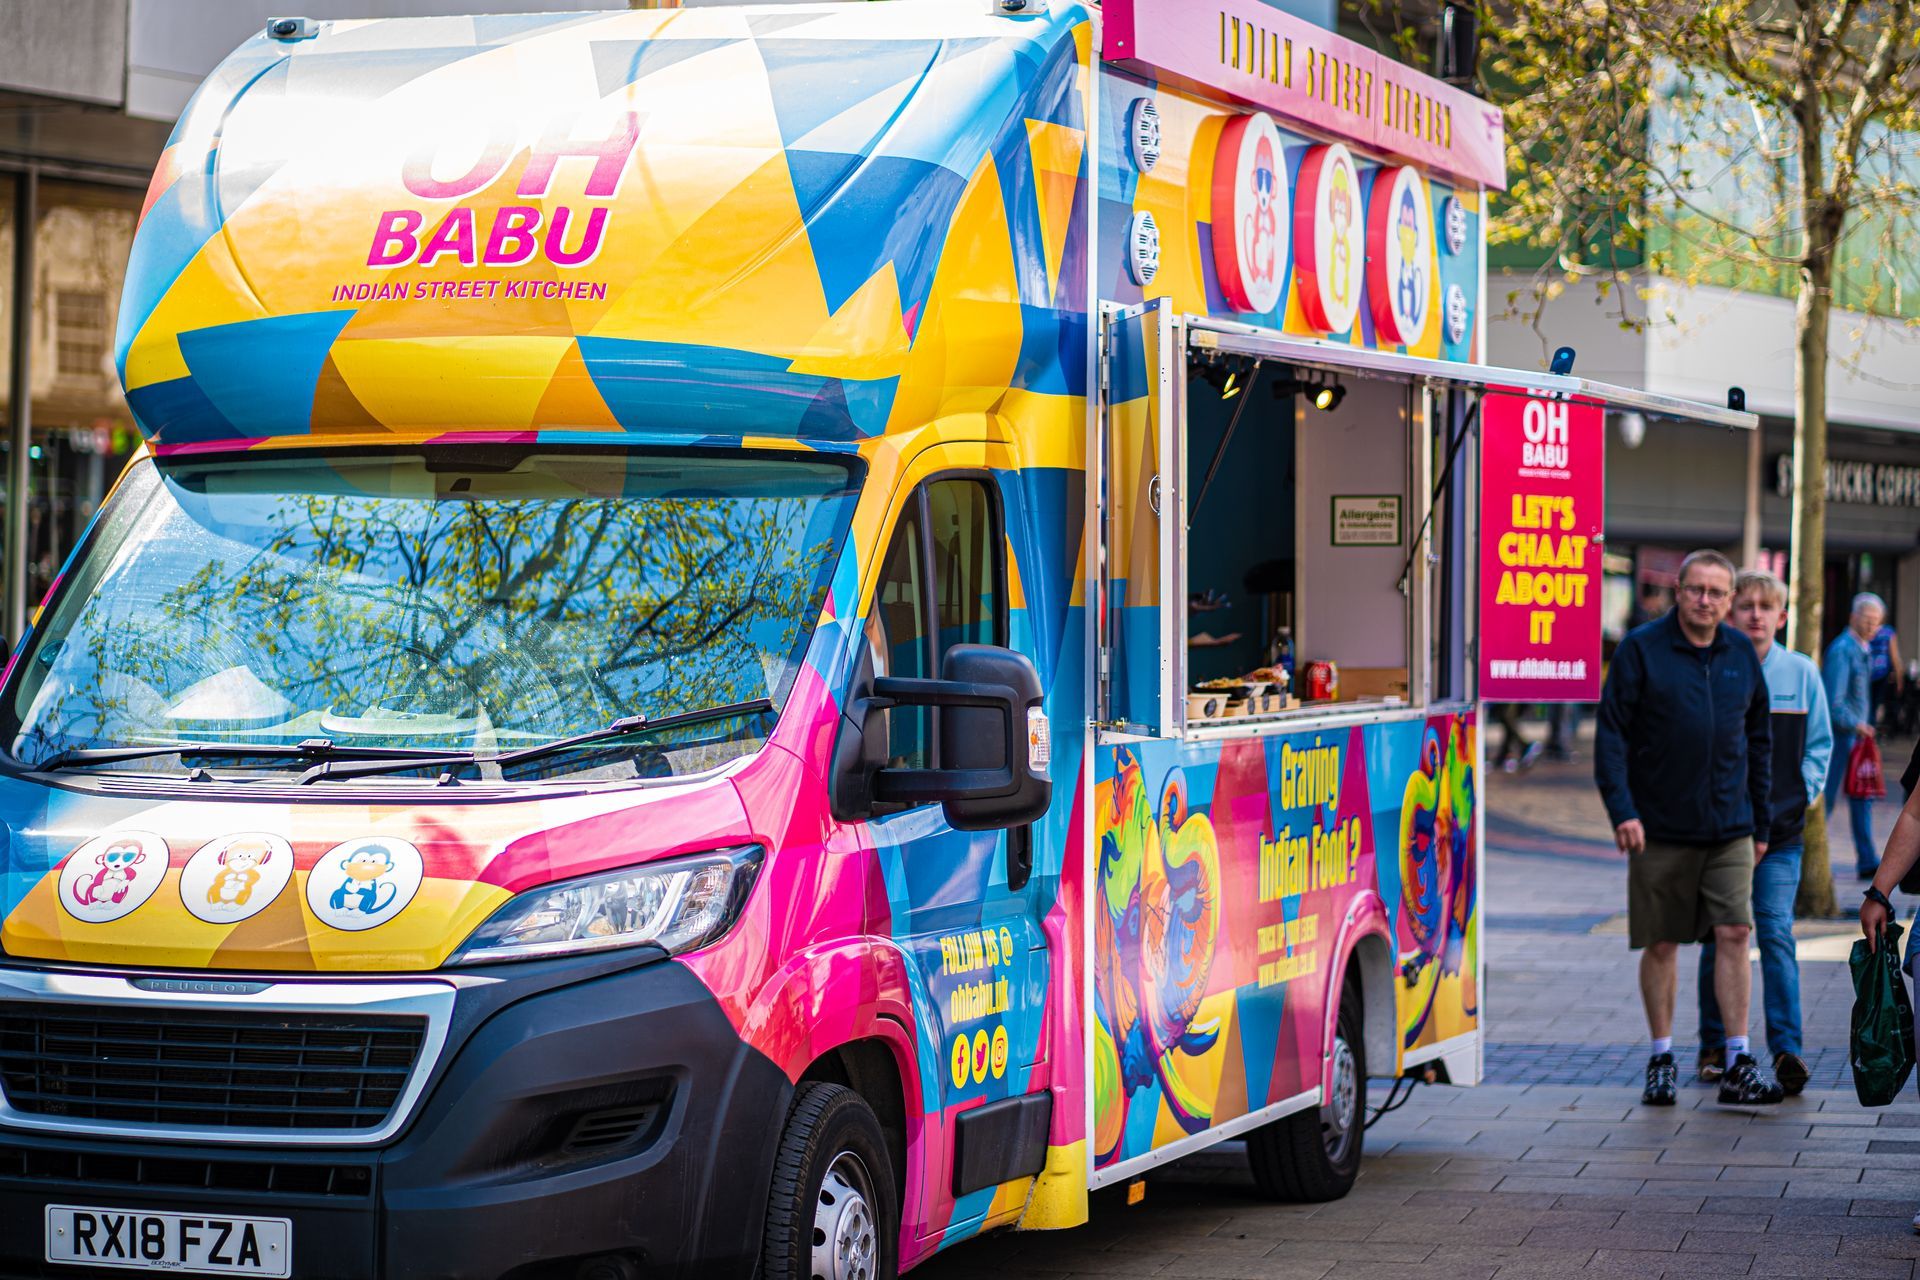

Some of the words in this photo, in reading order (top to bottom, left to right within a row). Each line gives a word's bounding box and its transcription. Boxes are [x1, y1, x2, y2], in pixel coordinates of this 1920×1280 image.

[1219, 11, 1291, 89] INDIAN
[1306, 47, 1371, 119] STREET
[1384, 80, 1450, 149] KITCHEN
[402, 110, 649, 199] OH
[366, 206, 610, 268] BABU
[332, 283, 409, 301] INDIAN
[414, 280, 500, 299] STREET
[505, 280, 607, 300] KITCHEN
[1522, 399, 1569, 445] OH
[1522, 441, 1569, 469] BABU
[1511, 494, 1576, 531] LET'S
[1497, 532, 1587, 569] CHAAT
[1495, 571, 1589, 607] ABOUT
[1529, 610, 1556, 644] IT
[1281, 736, 1339, 811] Craving
[1259, 824, 1309, 903] Indian
[940, 931, 983, 976] FOLLOW
[982, 928, 999, 967] US
[150, 981, 249, 993] PEUGEOT
[73, 1212, 165, 1260] RX18
[179, 1219, 261, 1267] FZA
